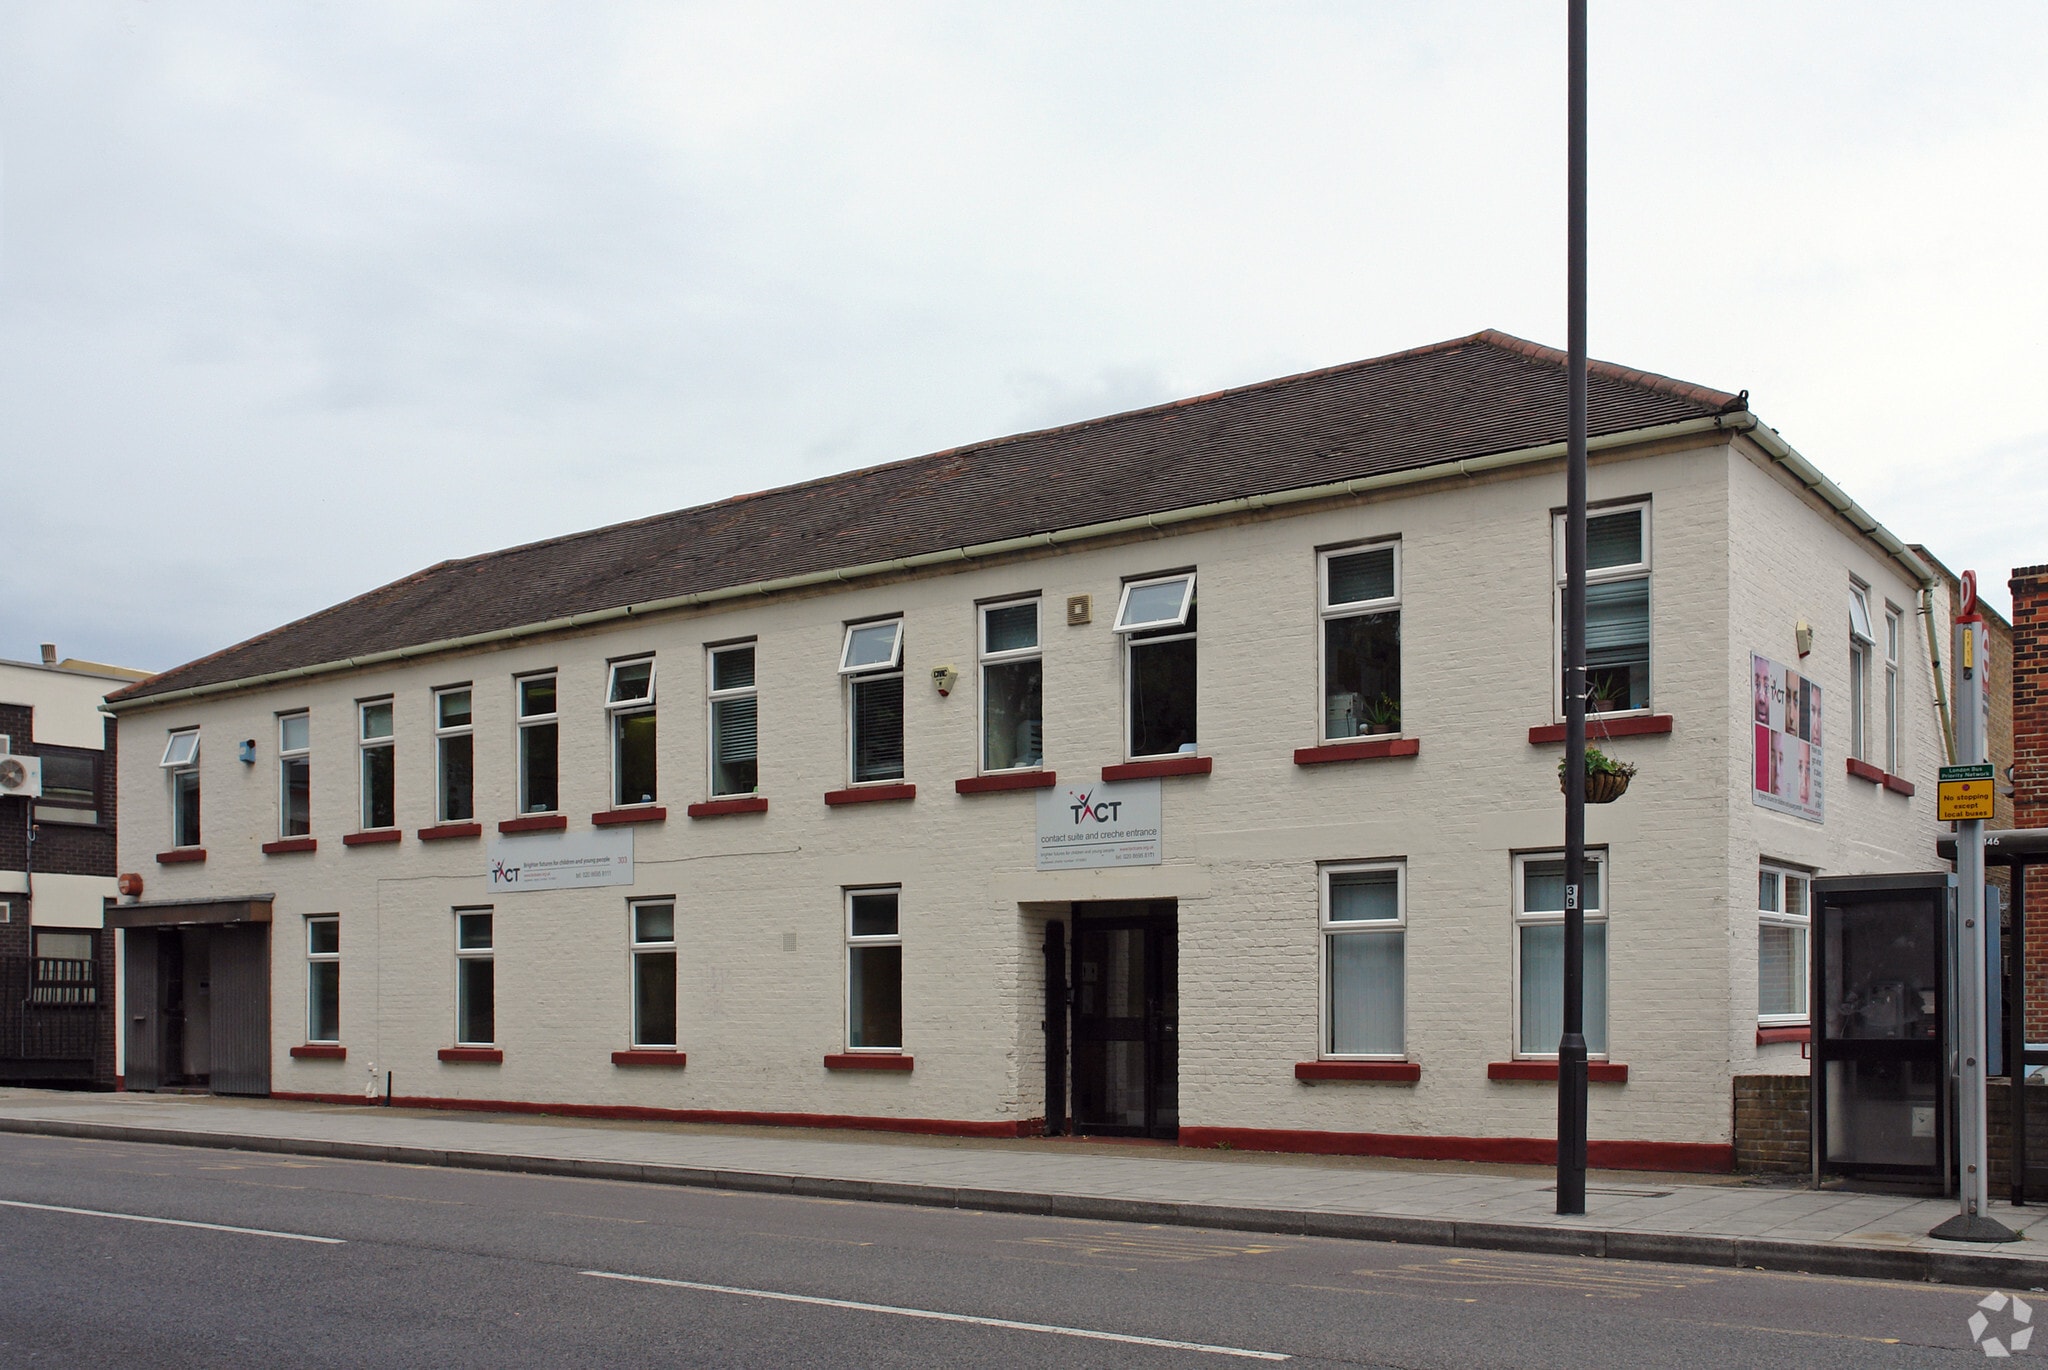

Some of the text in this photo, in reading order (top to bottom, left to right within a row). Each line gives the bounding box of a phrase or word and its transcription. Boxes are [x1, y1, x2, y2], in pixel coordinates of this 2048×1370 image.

[1957, 793, 1989, 801] stopping
[1070, 794, 1122, 825] TACT
[1041, 828, 1157, 843] contact suite and creche entrance
[617, 856, 628, 864] 303
[492, 862, 520, 883] TACT
